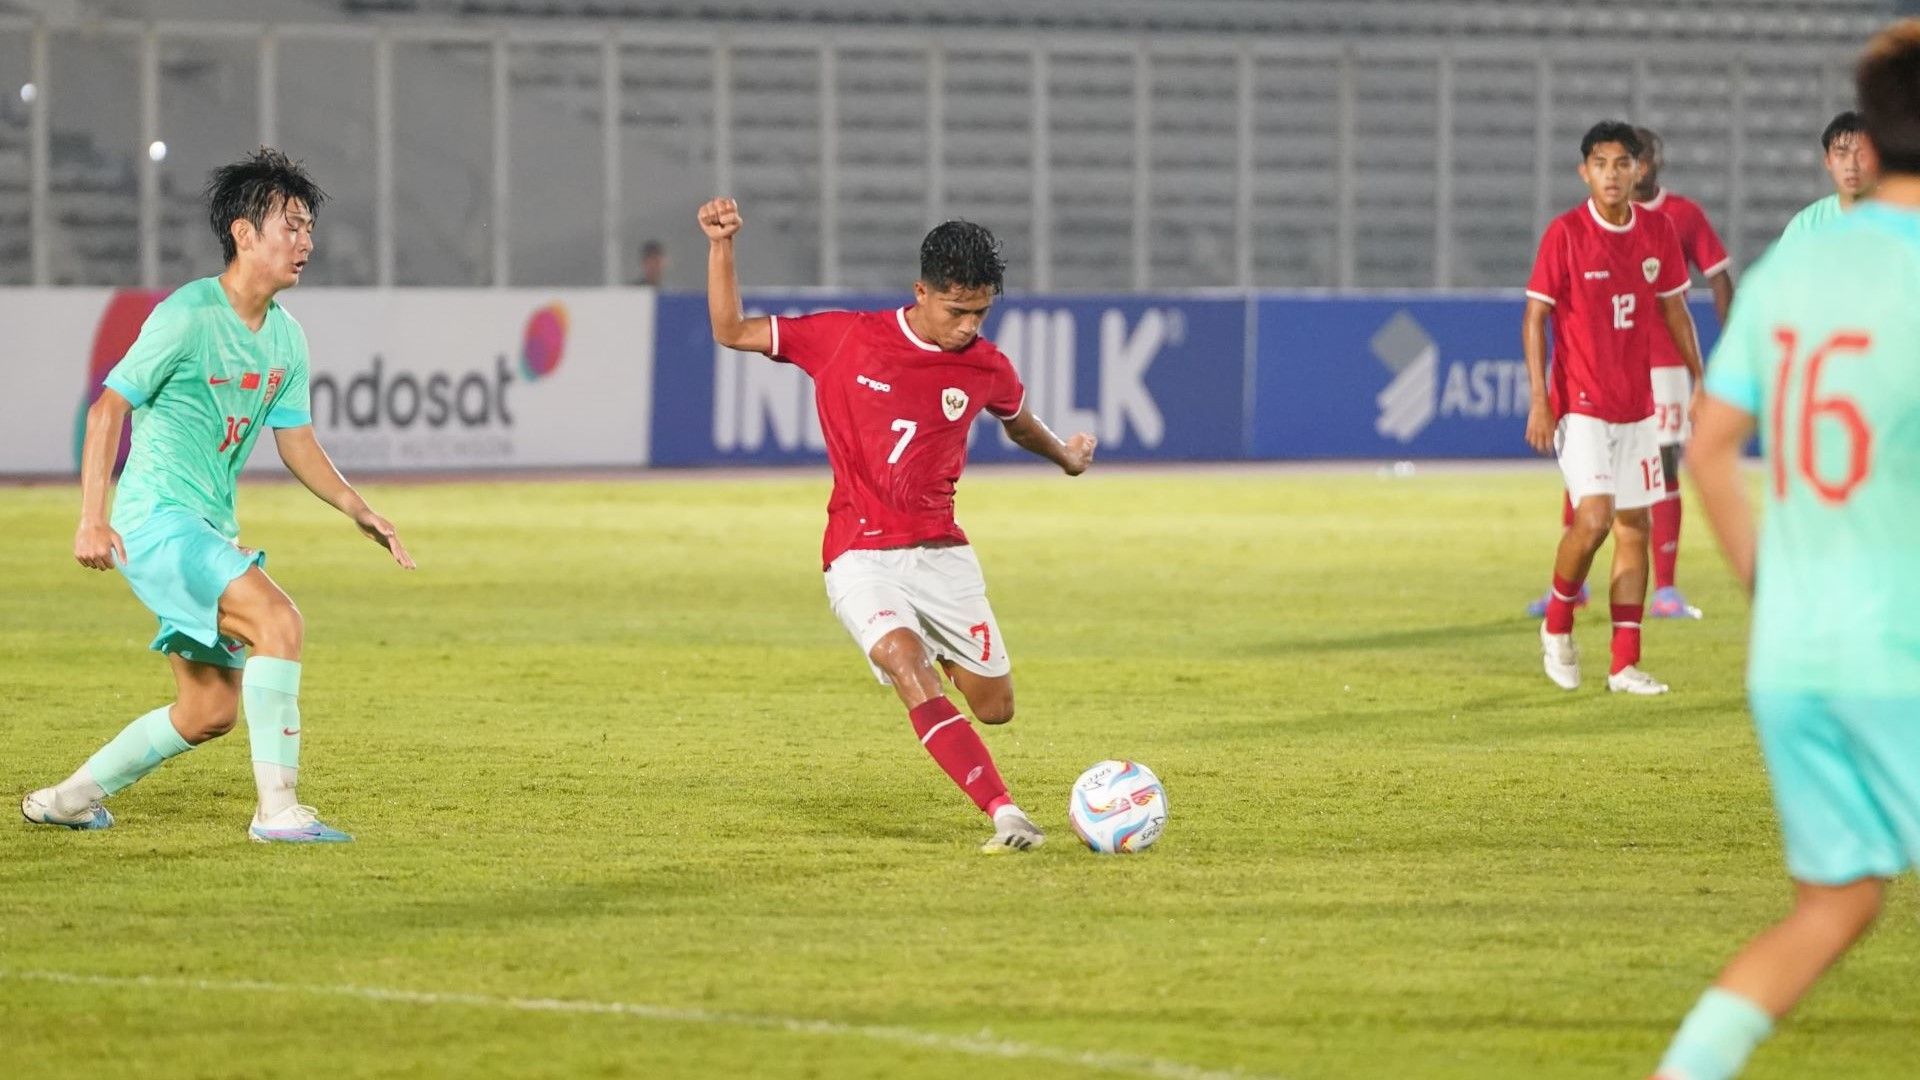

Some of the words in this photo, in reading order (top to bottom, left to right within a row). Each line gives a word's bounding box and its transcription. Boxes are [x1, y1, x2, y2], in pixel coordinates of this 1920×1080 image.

[1612, 292, 1636, 330] 12
[310, 353, 513, 430] ndosat
[1440, 360, 1534, 417] ASTR
[1772, 328, 1871, 504] 16
[887, 418, 918, 464] 7
[1640, 456, 1662, 491] 12
[968, 620, 991, 662] 7
